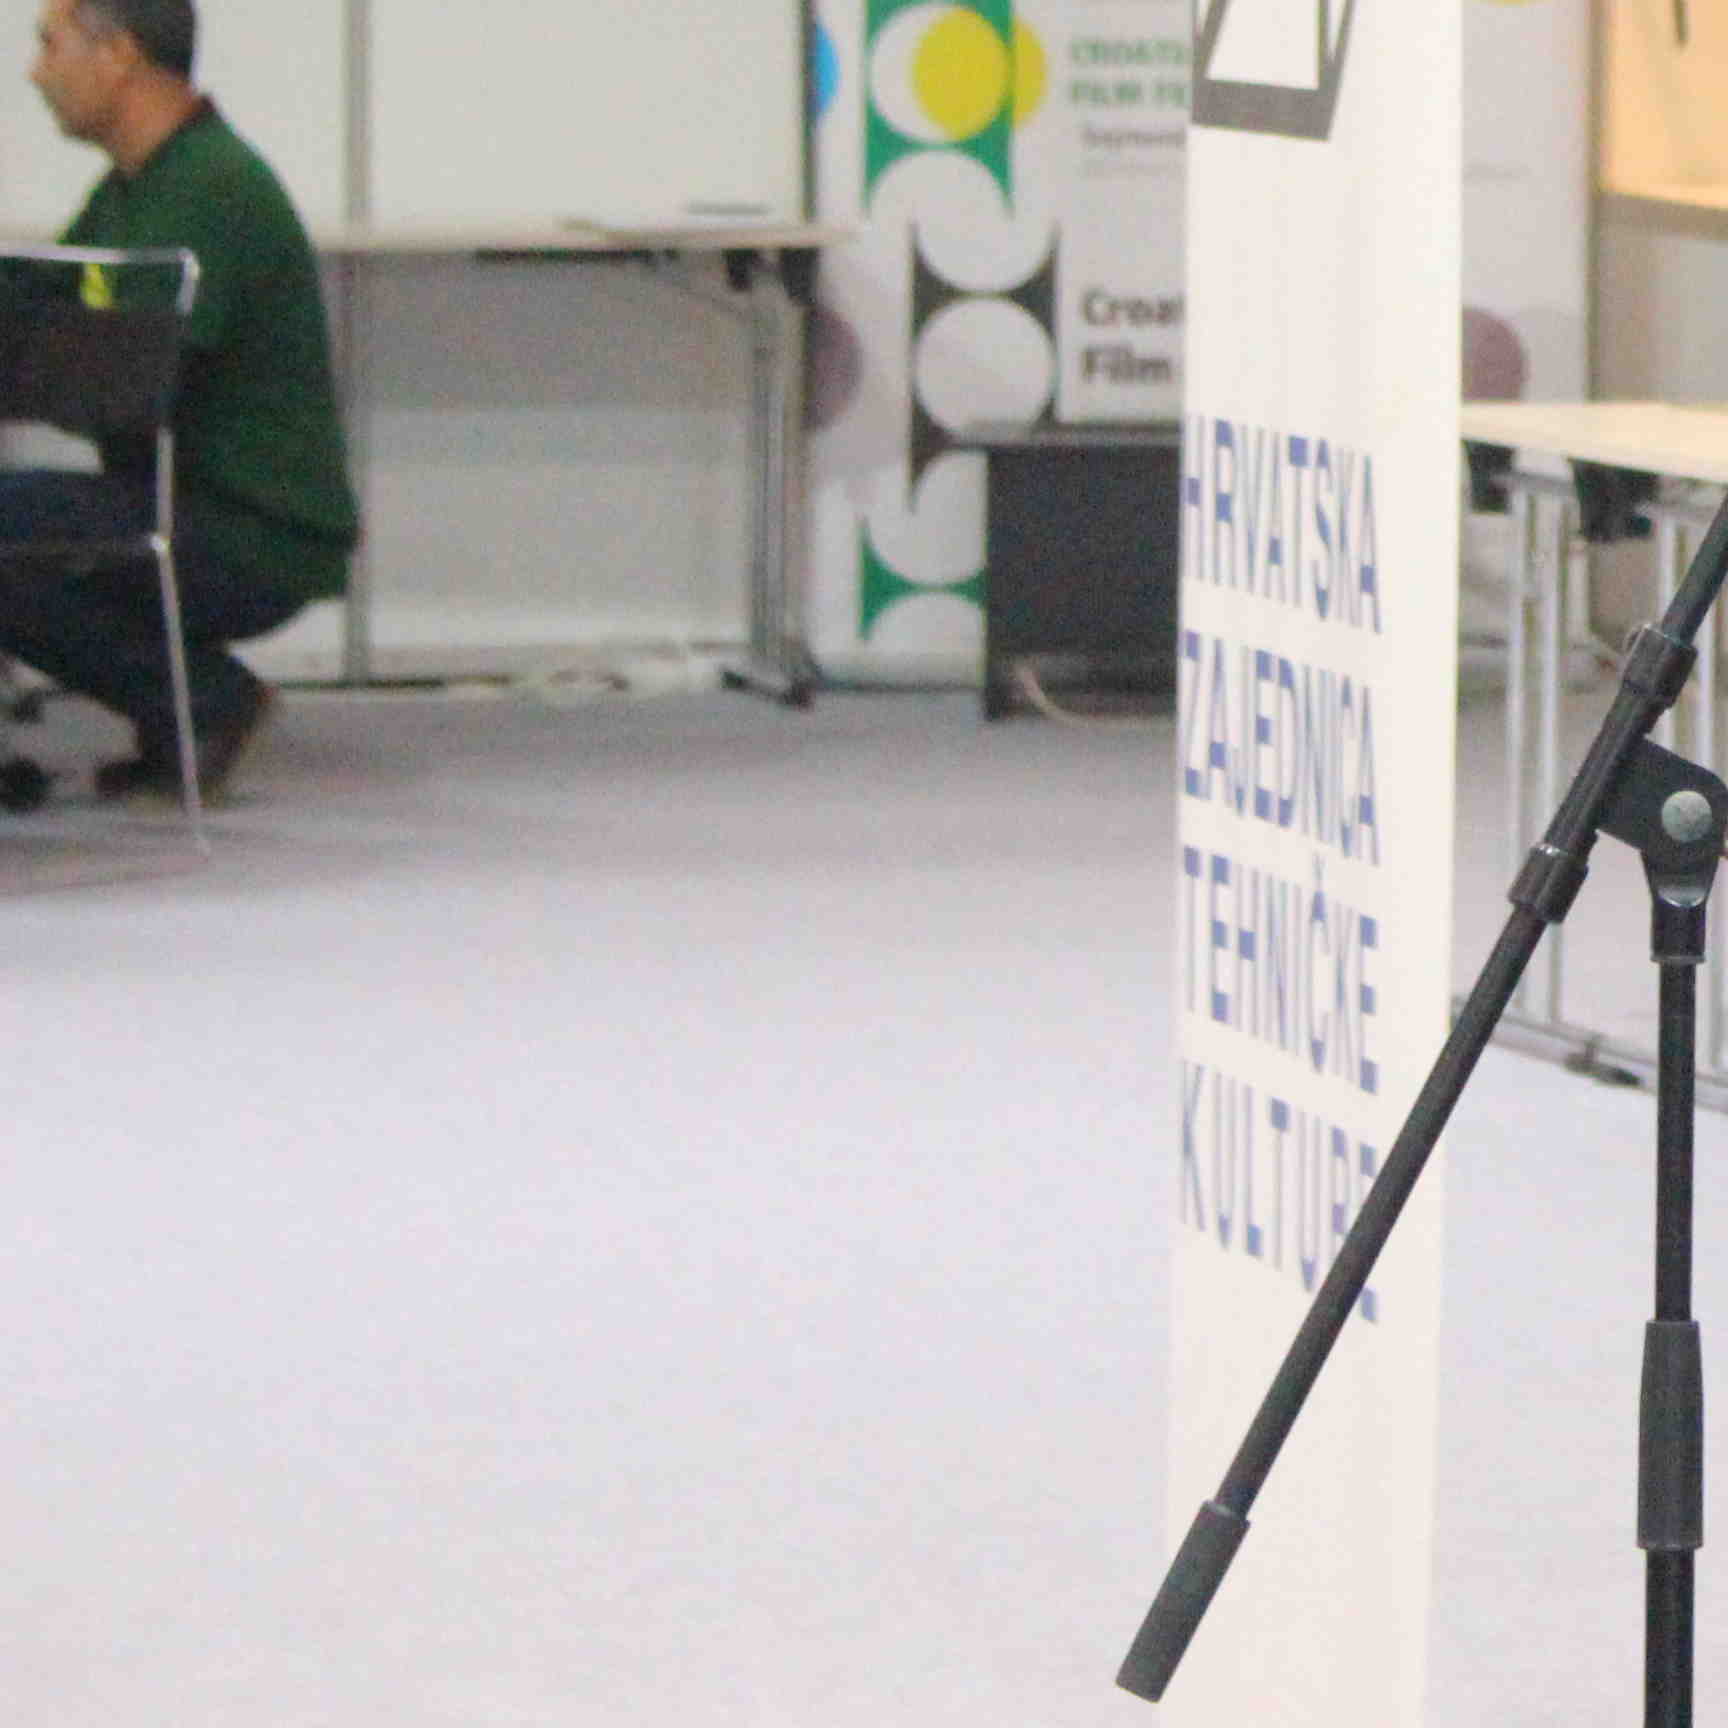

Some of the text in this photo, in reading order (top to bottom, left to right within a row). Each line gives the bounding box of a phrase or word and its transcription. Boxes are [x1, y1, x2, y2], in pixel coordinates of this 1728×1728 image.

[1182, 413, 1382, 635] HRVATSKA
[1180, 629, 1381, 867] ZAJEDNICA
[1184, 845, 1378, 1096] TEHNIČKE
